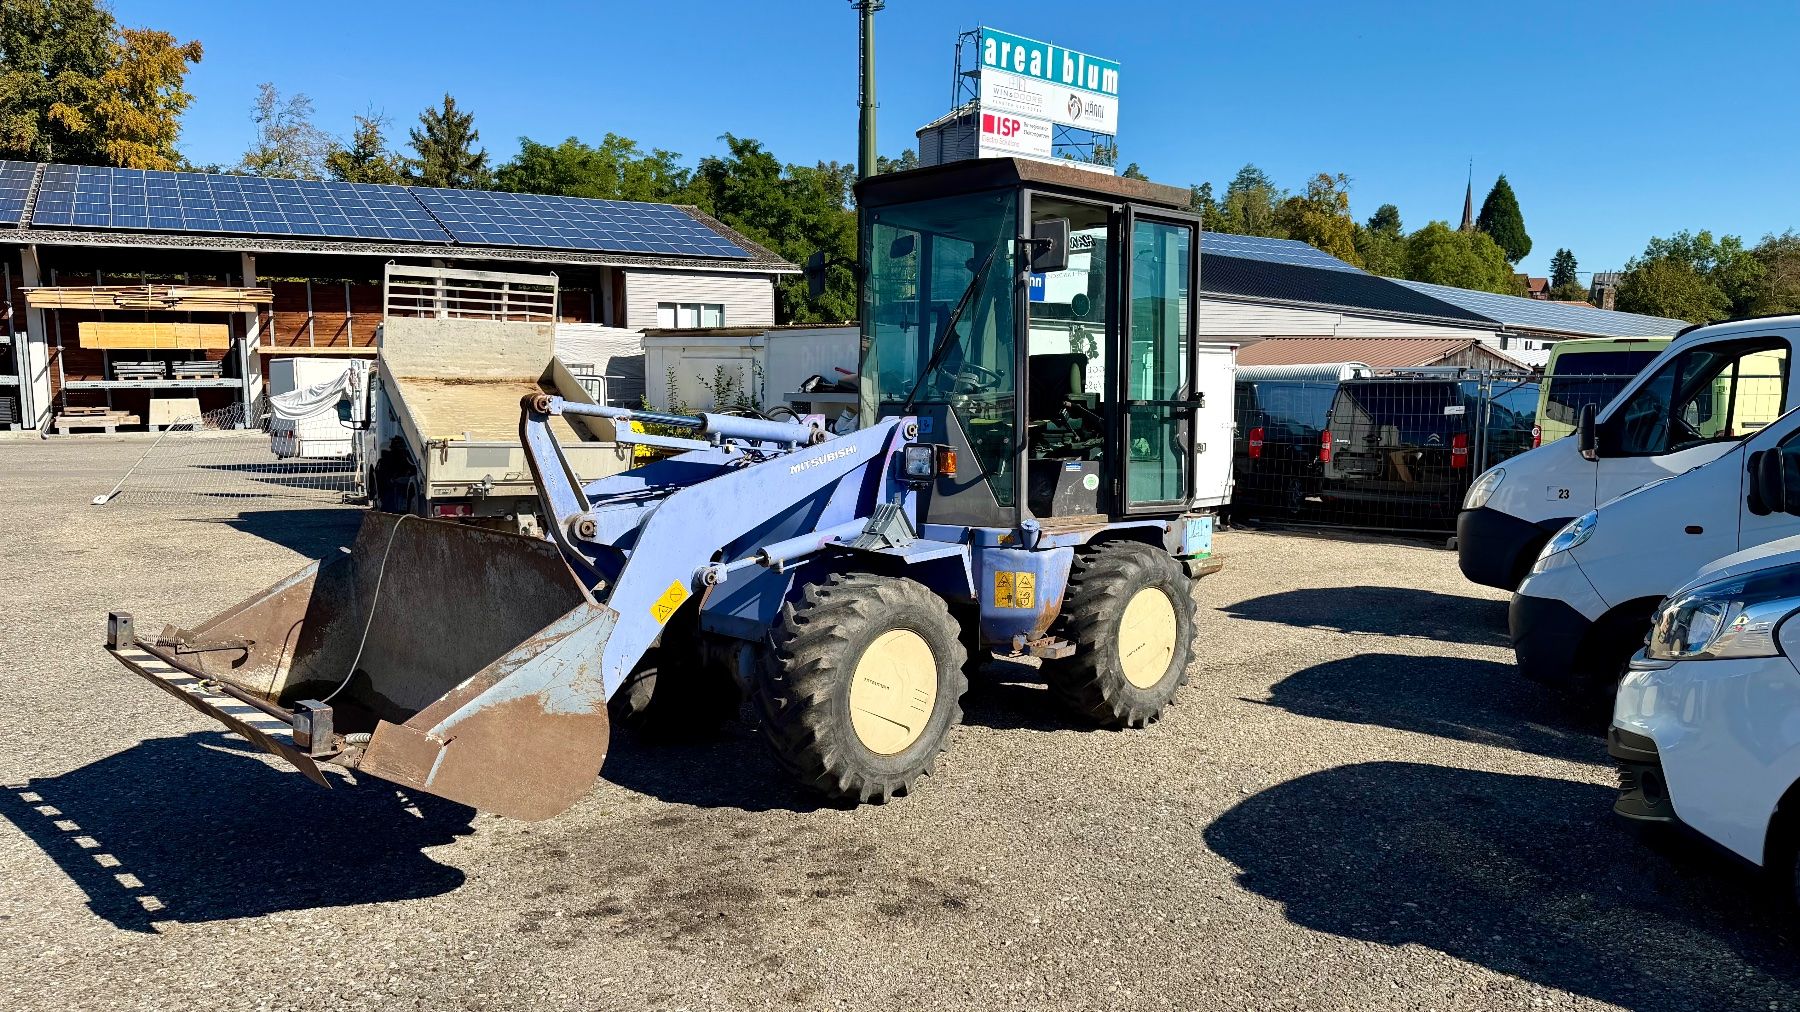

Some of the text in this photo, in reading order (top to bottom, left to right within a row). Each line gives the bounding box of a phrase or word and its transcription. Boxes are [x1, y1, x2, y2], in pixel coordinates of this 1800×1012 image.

[984, 37, 1118, 94] areal blum
[997, 116, 1021, 138] ISP
[790, 445, 857, 475] MITSUBISHI
[1558, 488, 1570, 499] 23
